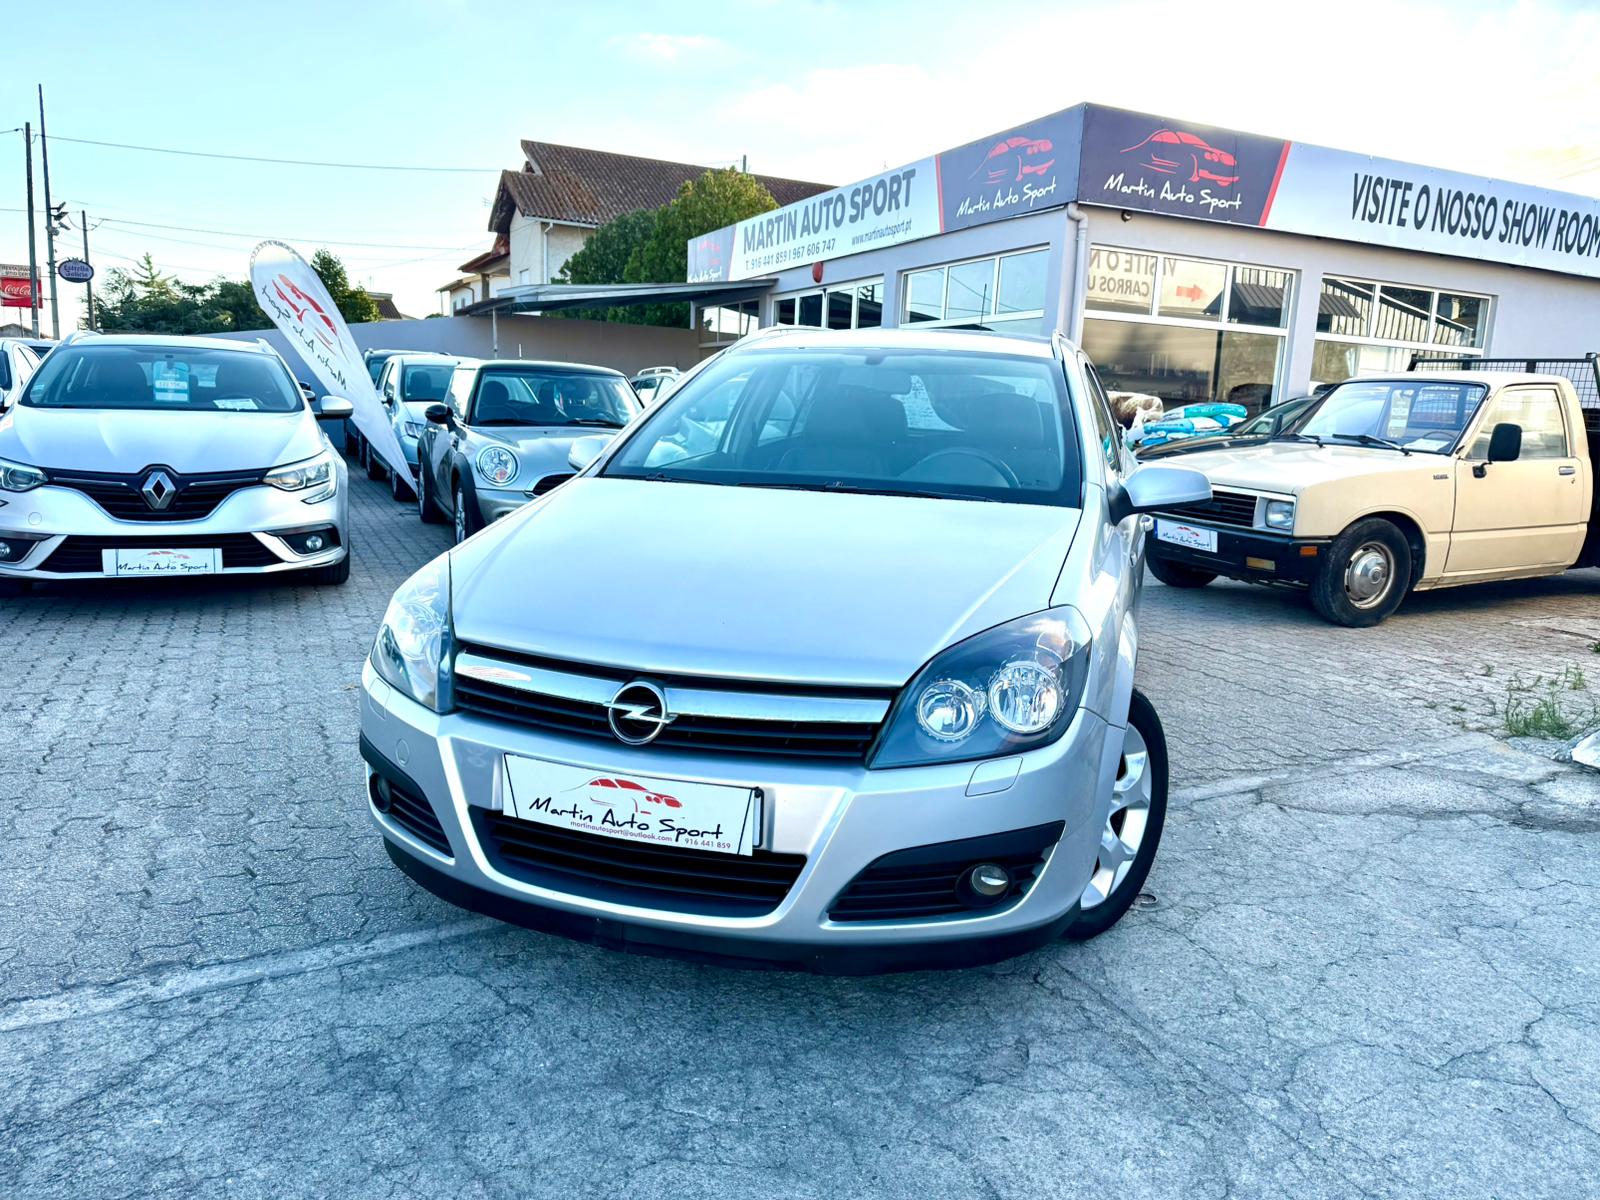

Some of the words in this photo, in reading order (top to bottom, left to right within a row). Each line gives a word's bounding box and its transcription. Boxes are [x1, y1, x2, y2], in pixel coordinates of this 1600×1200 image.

[743, 211, 797, 255] MARTIN
[800, 193, 845, 238] AUTO
[849, 168, 916, 223] SPORT
[956, 197, 991, 218] Martin
[993, 190, 1019, 209] Auto
[1022, 176, 1057, 207] Sport
[1104, 173, 1155, 198] Martin
[1160, 181, 1194, 203] Auto
[1199, 189, 1242, 214] Sport
[1352, 172, 1413, 227] VISITE
[1413, 184, 1430, 230] O
[1431, 187, 1498, 241] NOSSO
[1498, 199, 1556, 250] SHOW
[793, 246, 805, 259] 967
[807, 242, 820, 256] 606
[822, 238, 836, 252] 747
[153, 562, 177, 570] Auto
[180, 562, 208, 572] Sport
[528, 796, 593, 823] Martin
[601, 808, 650, 831] Auto
[658, 818, 723, 842] Sport
[570, 820, 673, 842] martinautosport@outlook.com
[684, 837, 699, 846] 916
[700, 839, 714, 847] 441
[716, 840, 731, 849] 859
